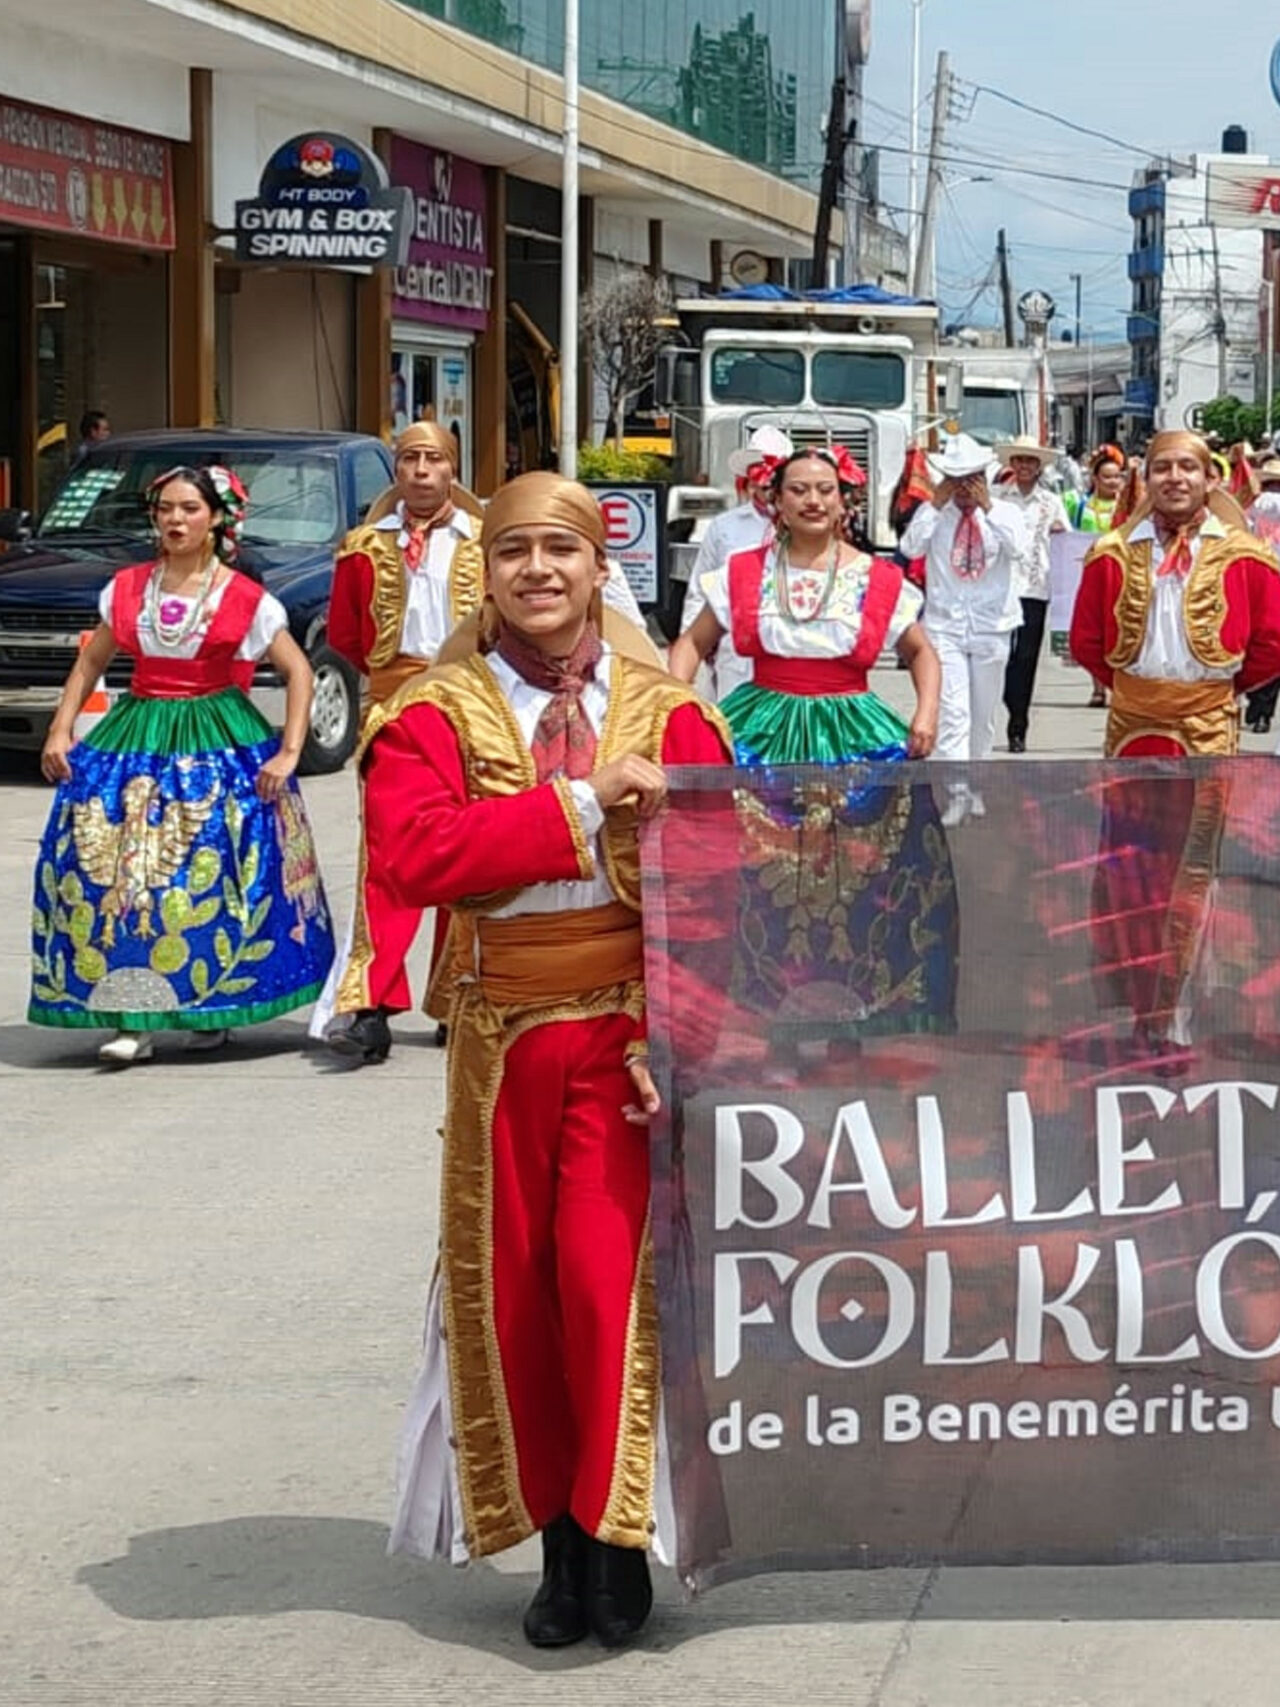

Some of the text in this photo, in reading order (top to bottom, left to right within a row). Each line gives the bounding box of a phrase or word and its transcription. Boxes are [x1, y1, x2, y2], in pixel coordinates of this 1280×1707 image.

[307, 188, 357, 202] BODY
[240, 208, 397, 232] GYM & BOX
[415, 197, 484, 254] ENTISTA
[249, 234, 387, 258] SPINNING
[601, 501, 630, 539] E
[714, 1081, 1279, 1230] BALLET
[708, 1400, 784, 1455] de
[806, 1394, 860, 1447] la
[883, 1383, 1249, 1443] Benemérita
